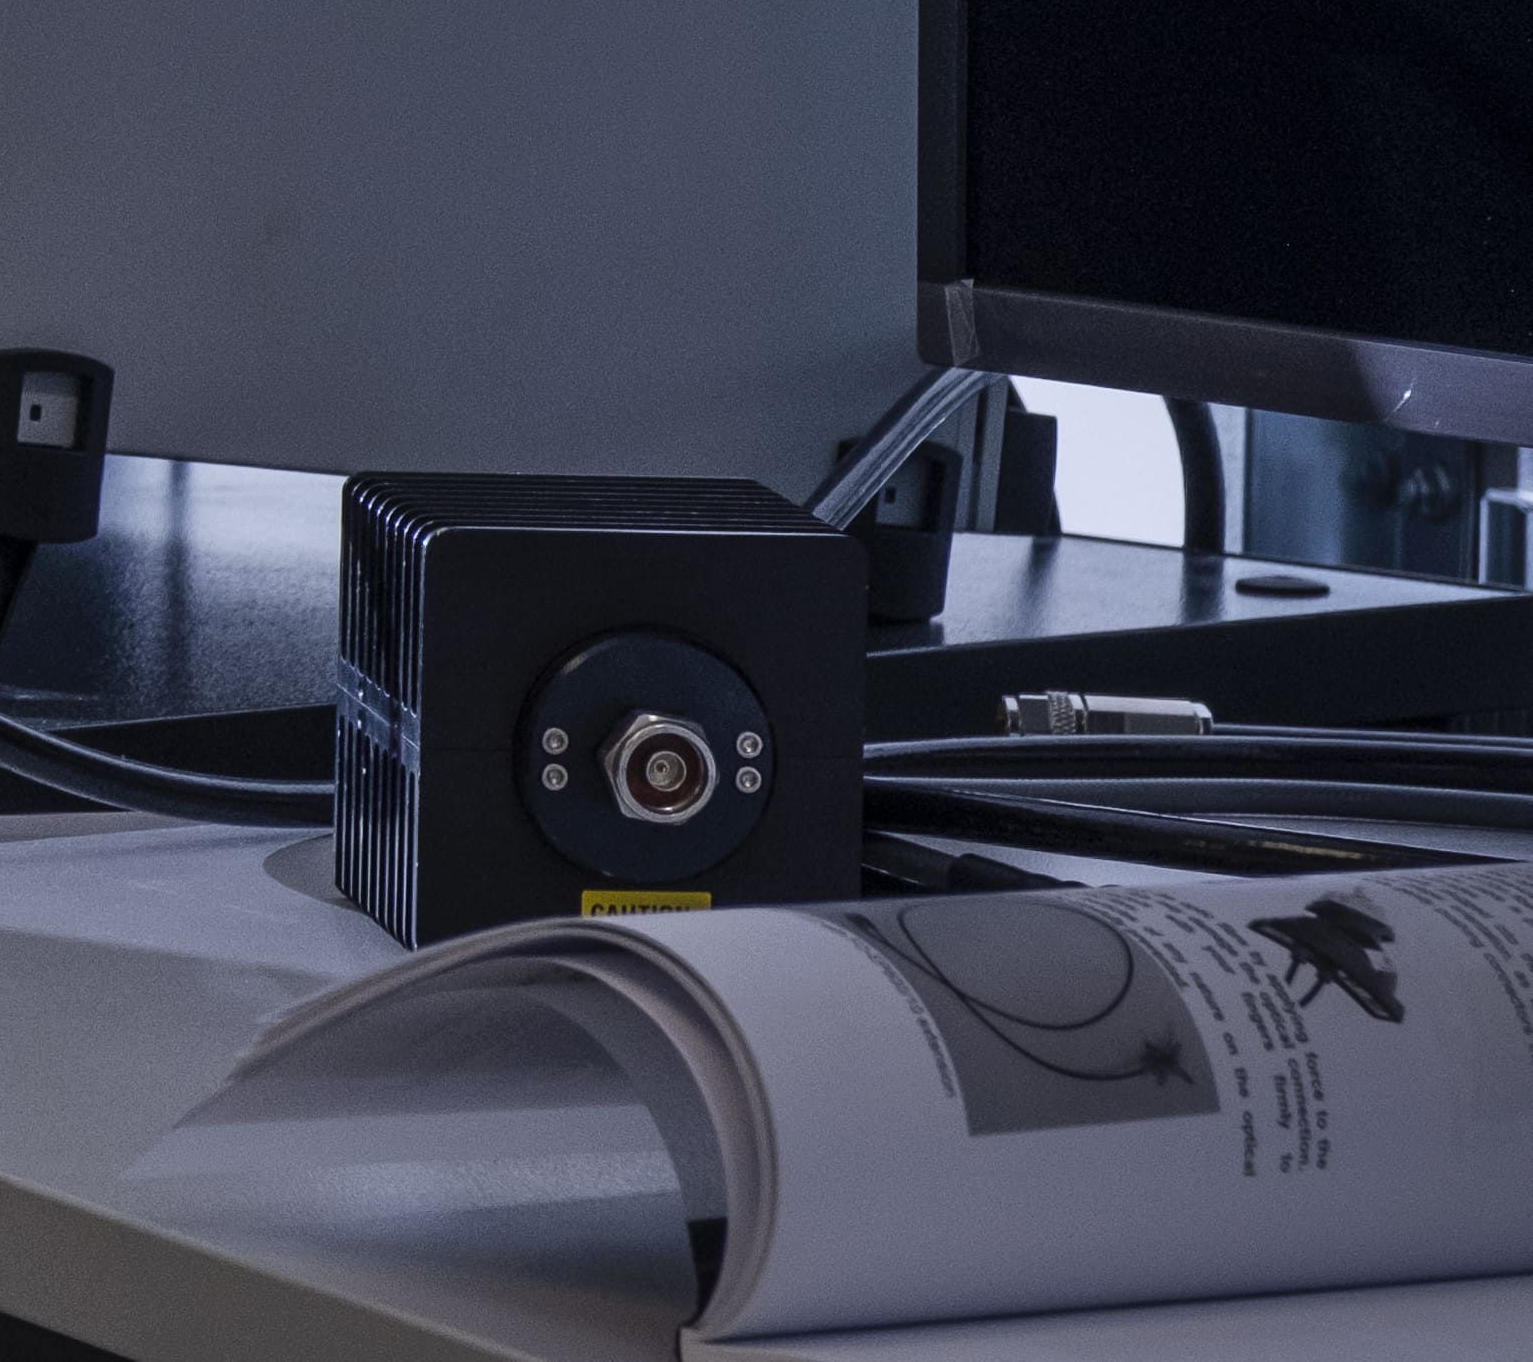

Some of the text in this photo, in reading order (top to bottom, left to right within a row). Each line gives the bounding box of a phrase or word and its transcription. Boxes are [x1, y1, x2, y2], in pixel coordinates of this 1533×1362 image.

[1258, 992, 1293, 1048] optical
[1242, 992, 1292, 1173] fingers firmly to
[1304, 1053, 1324, 1101] force
[1223, 1032, 1256, 1177] on the optical
[1316, 1111, 1328, 1129] to
[1317, 1139, 1331, 1170] the
